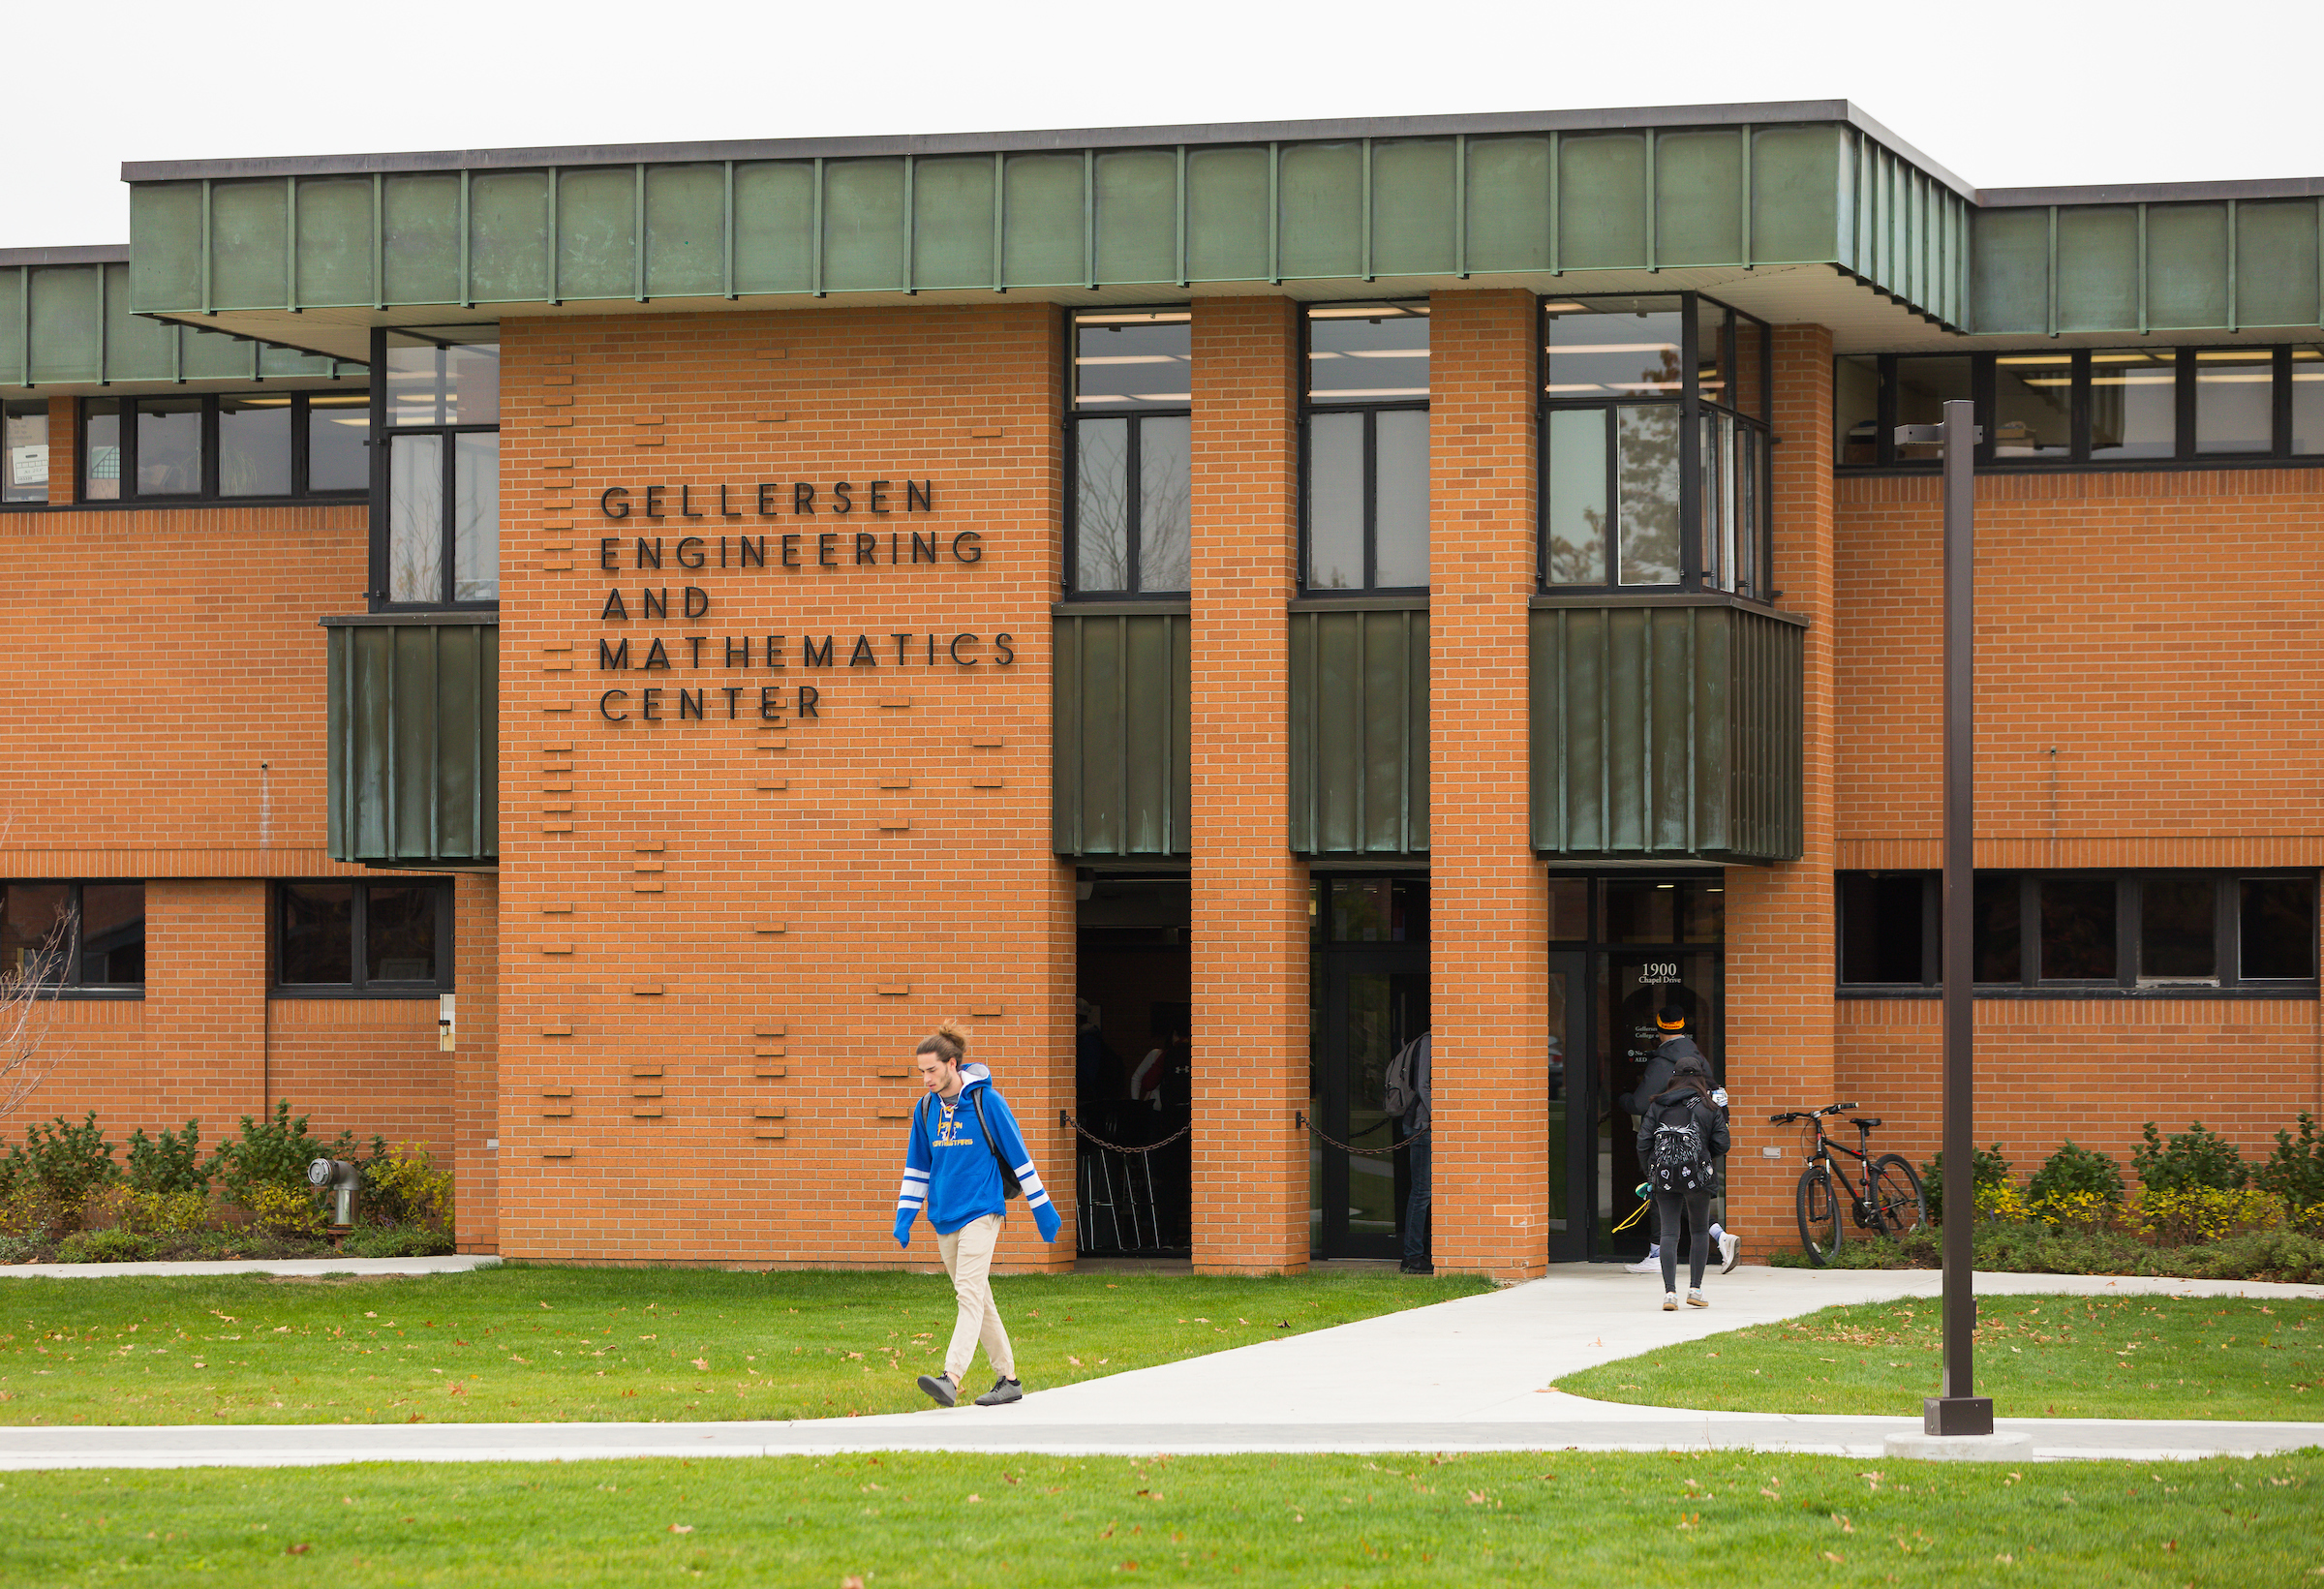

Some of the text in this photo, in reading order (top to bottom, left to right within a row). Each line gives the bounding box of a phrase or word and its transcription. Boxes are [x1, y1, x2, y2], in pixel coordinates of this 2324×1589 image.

[600, 479, 932, 519] GELLERSEN
[600, 531, 982, 570] ENGINEERING
[600, 586, 709, 621] AND
[599, 632, 1014, 670] MATHEMATICS
[599, 686, 819, 721] CENTER
[1638, 975, 1682, 986] Chapel Drive
[1642, 963, 1677, 977] 1900
